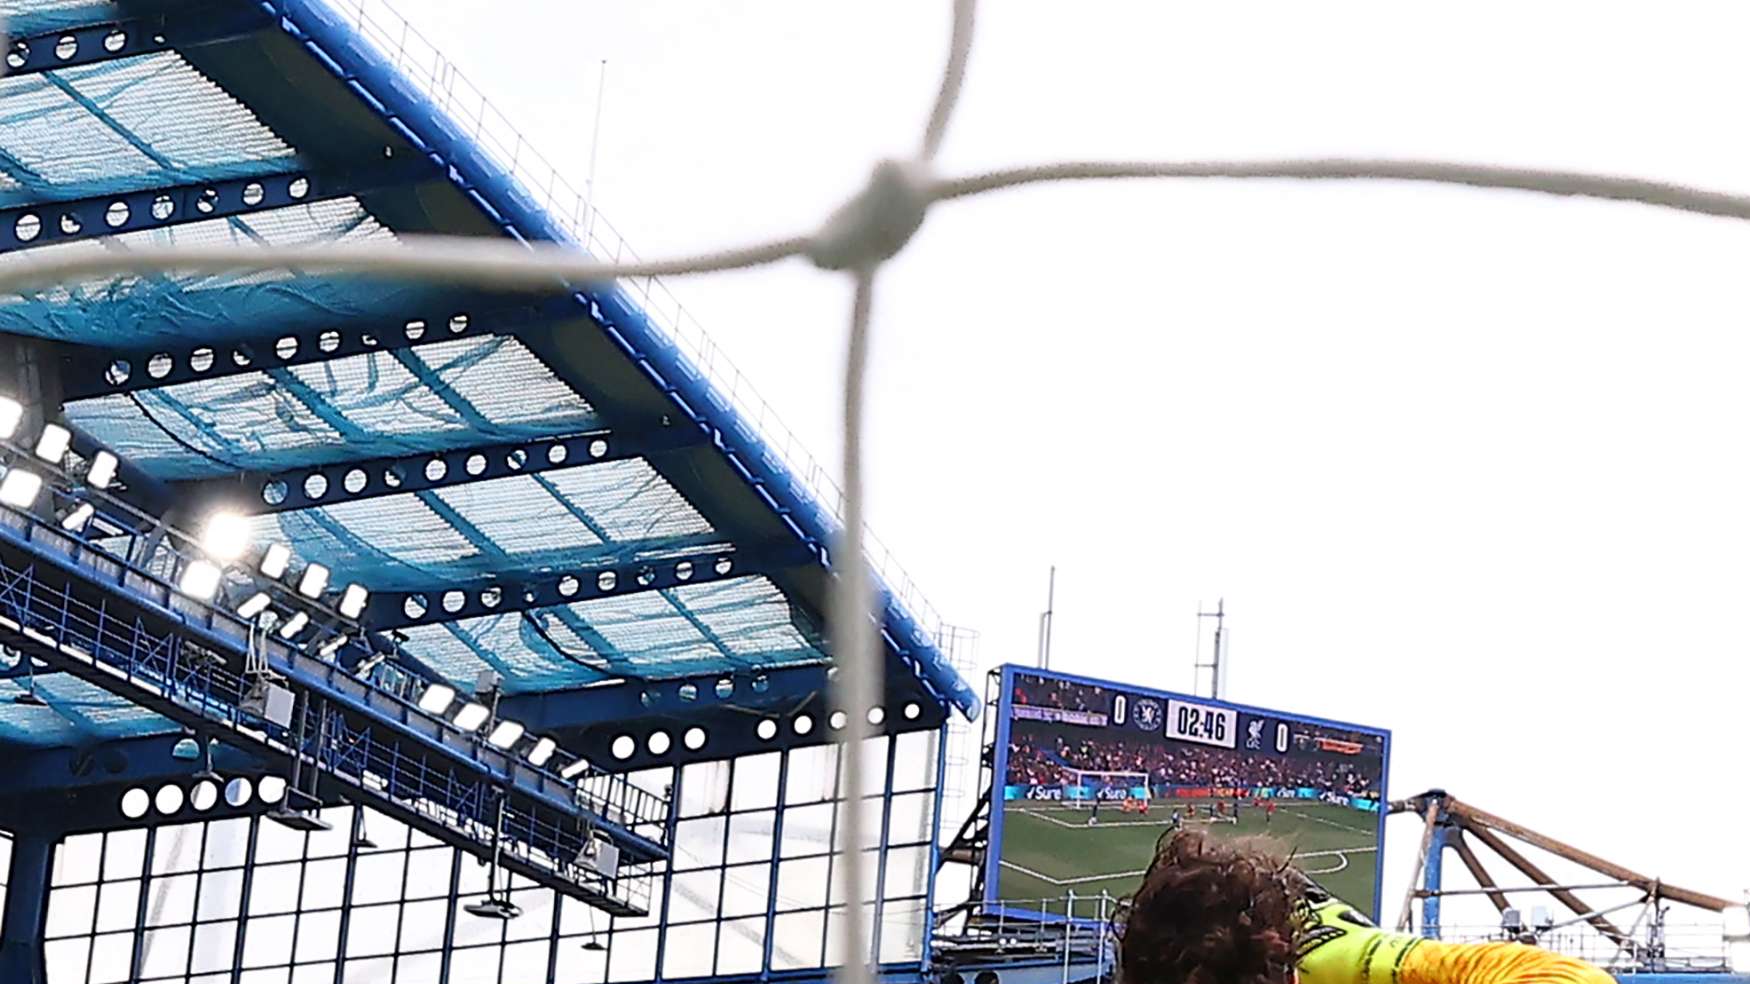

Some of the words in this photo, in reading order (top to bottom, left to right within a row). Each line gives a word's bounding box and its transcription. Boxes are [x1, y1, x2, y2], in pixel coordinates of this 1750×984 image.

[1113, 695, 1127, 724] 0
[1178, 706, 1226, 741] 02:46
[1276, 722, 1289, 752] 0
